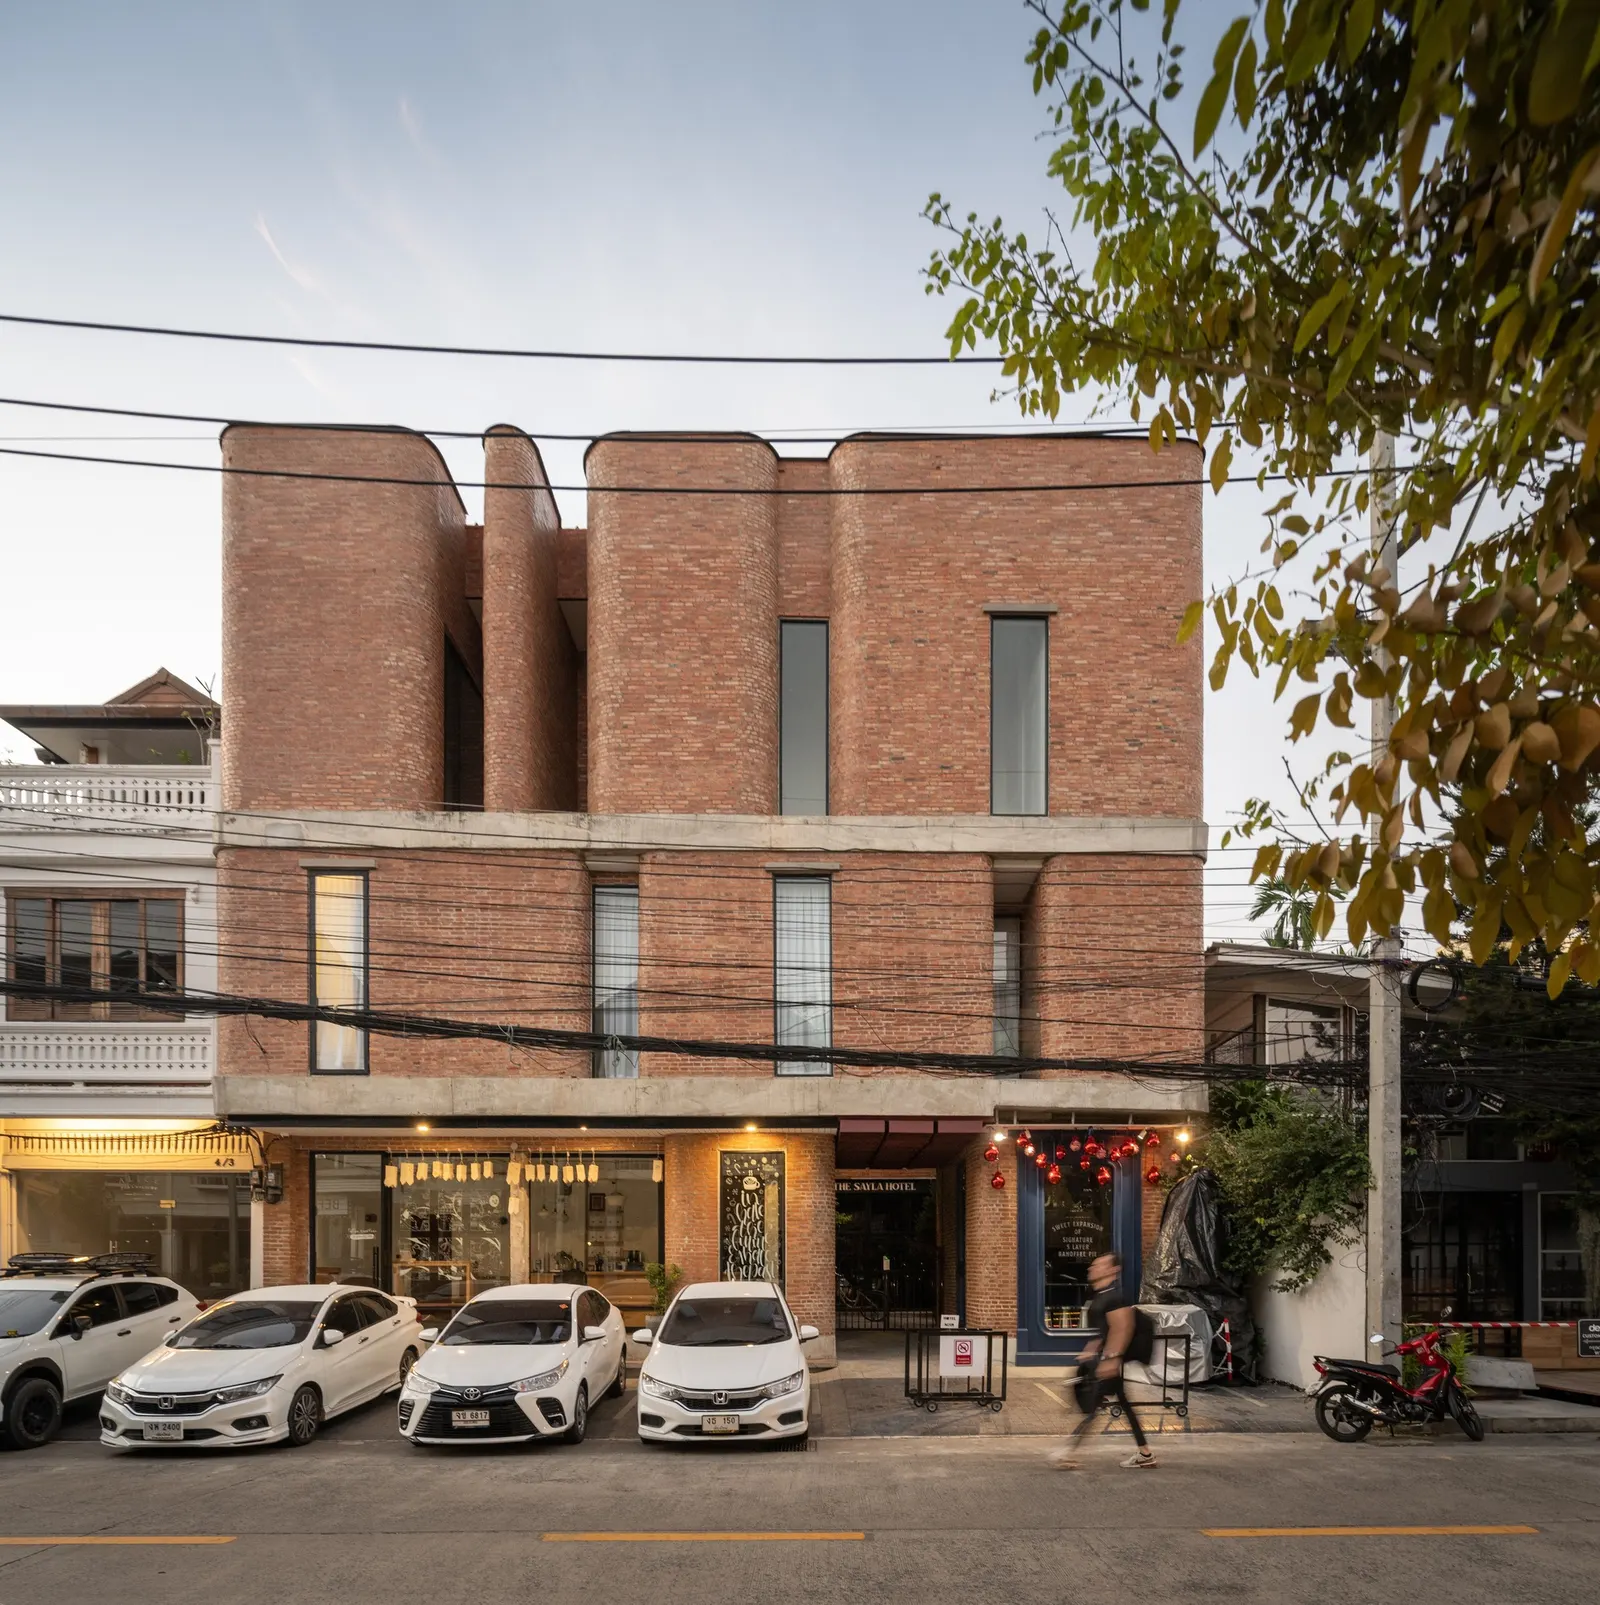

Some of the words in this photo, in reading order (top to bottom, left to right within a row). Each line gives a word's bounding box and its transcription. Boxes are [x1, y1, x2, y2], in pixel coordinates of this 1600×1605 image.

[214, 1158, 234, 1167] 4/3
[834, 1182, 851, 1191] THE
[854, 1182, 884, 1191] SAYLA
[886, 1182, 916, 1191] HOTEL
[1052, 1222, 1070, 1232] SWEET
[1072, 1221, 1104, 1232] EXPANSION
